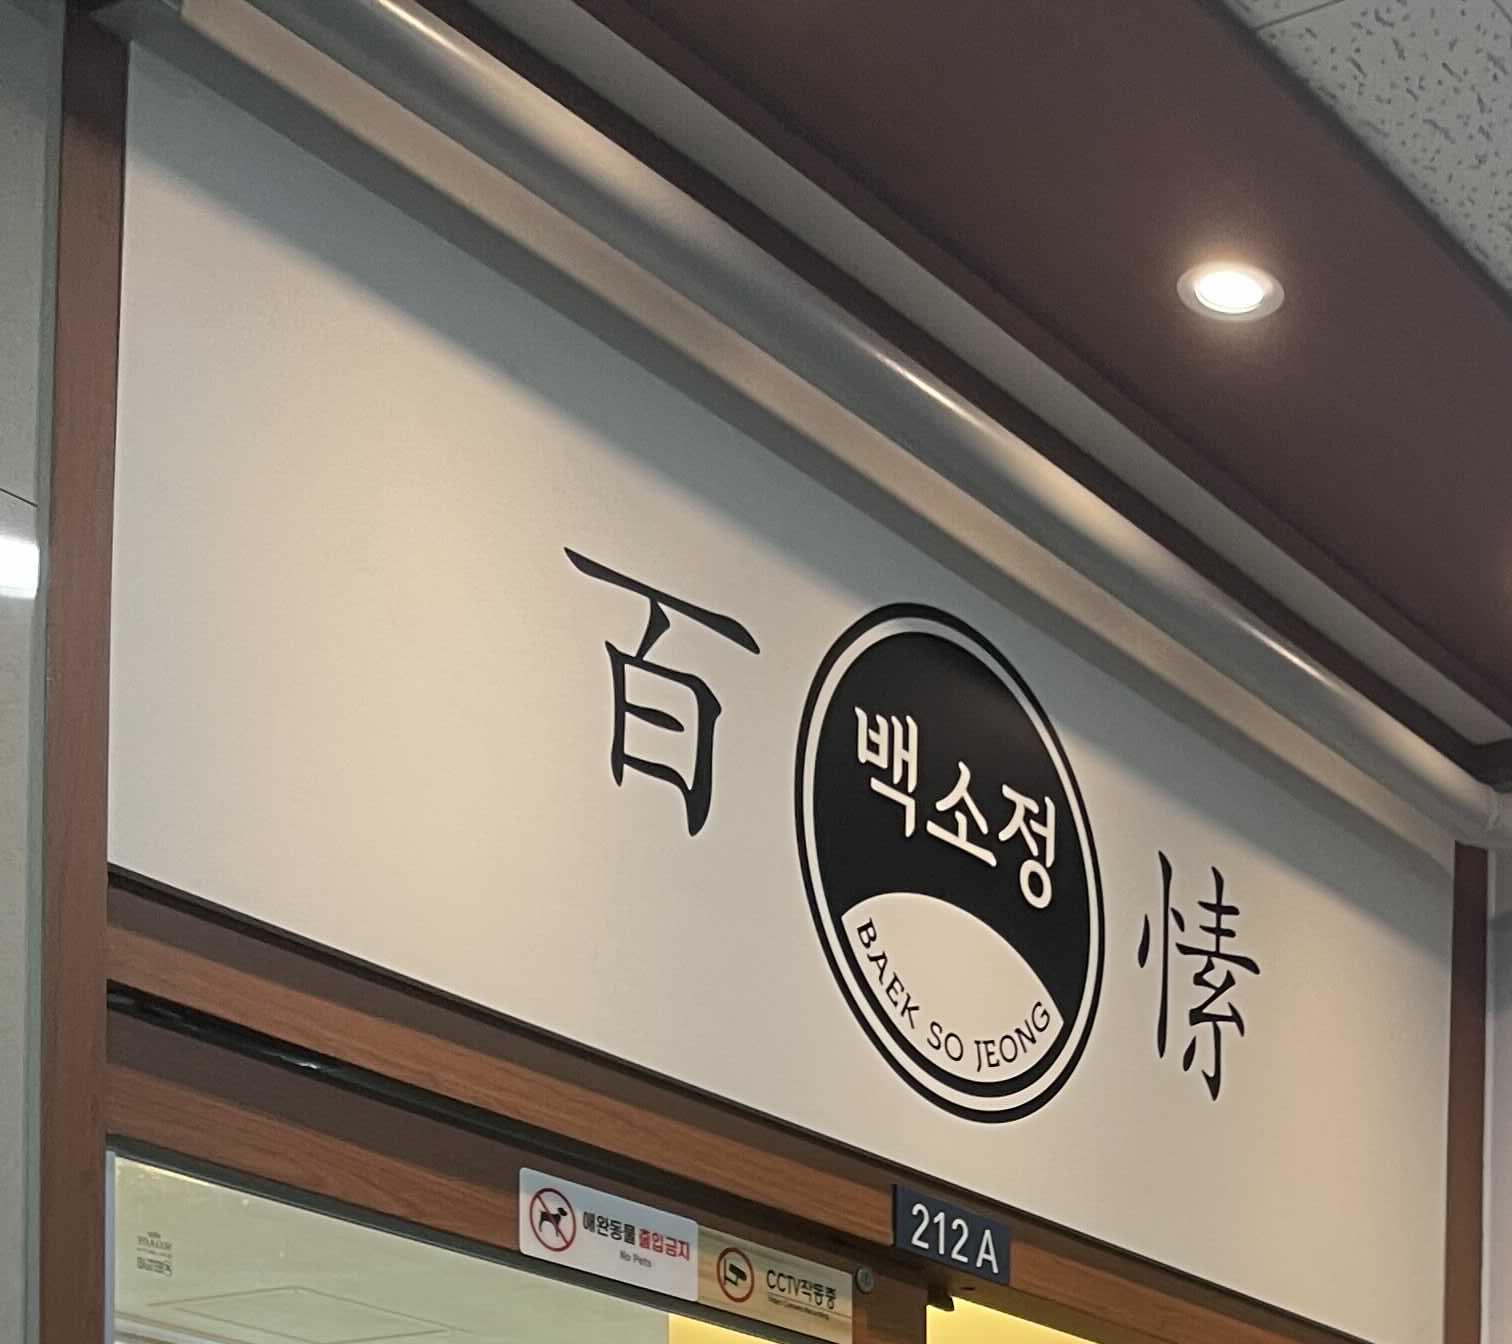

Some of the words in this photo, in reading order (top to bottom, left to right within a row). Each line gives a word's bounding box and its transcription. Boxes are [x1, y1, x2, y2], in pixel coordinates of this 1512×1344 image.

[563, 547, 761, 837] 百
[854, 706, 1057, 910] 백소정
[856, 917, 920, 1030] BAEK
[927, 1024, 965, 1063] SO
[974, 1000, 1053, 1073] JEONG
[583, 1211, 636, 1246] 애완동물
[639, 1228, 690, 1261] 출입금지
